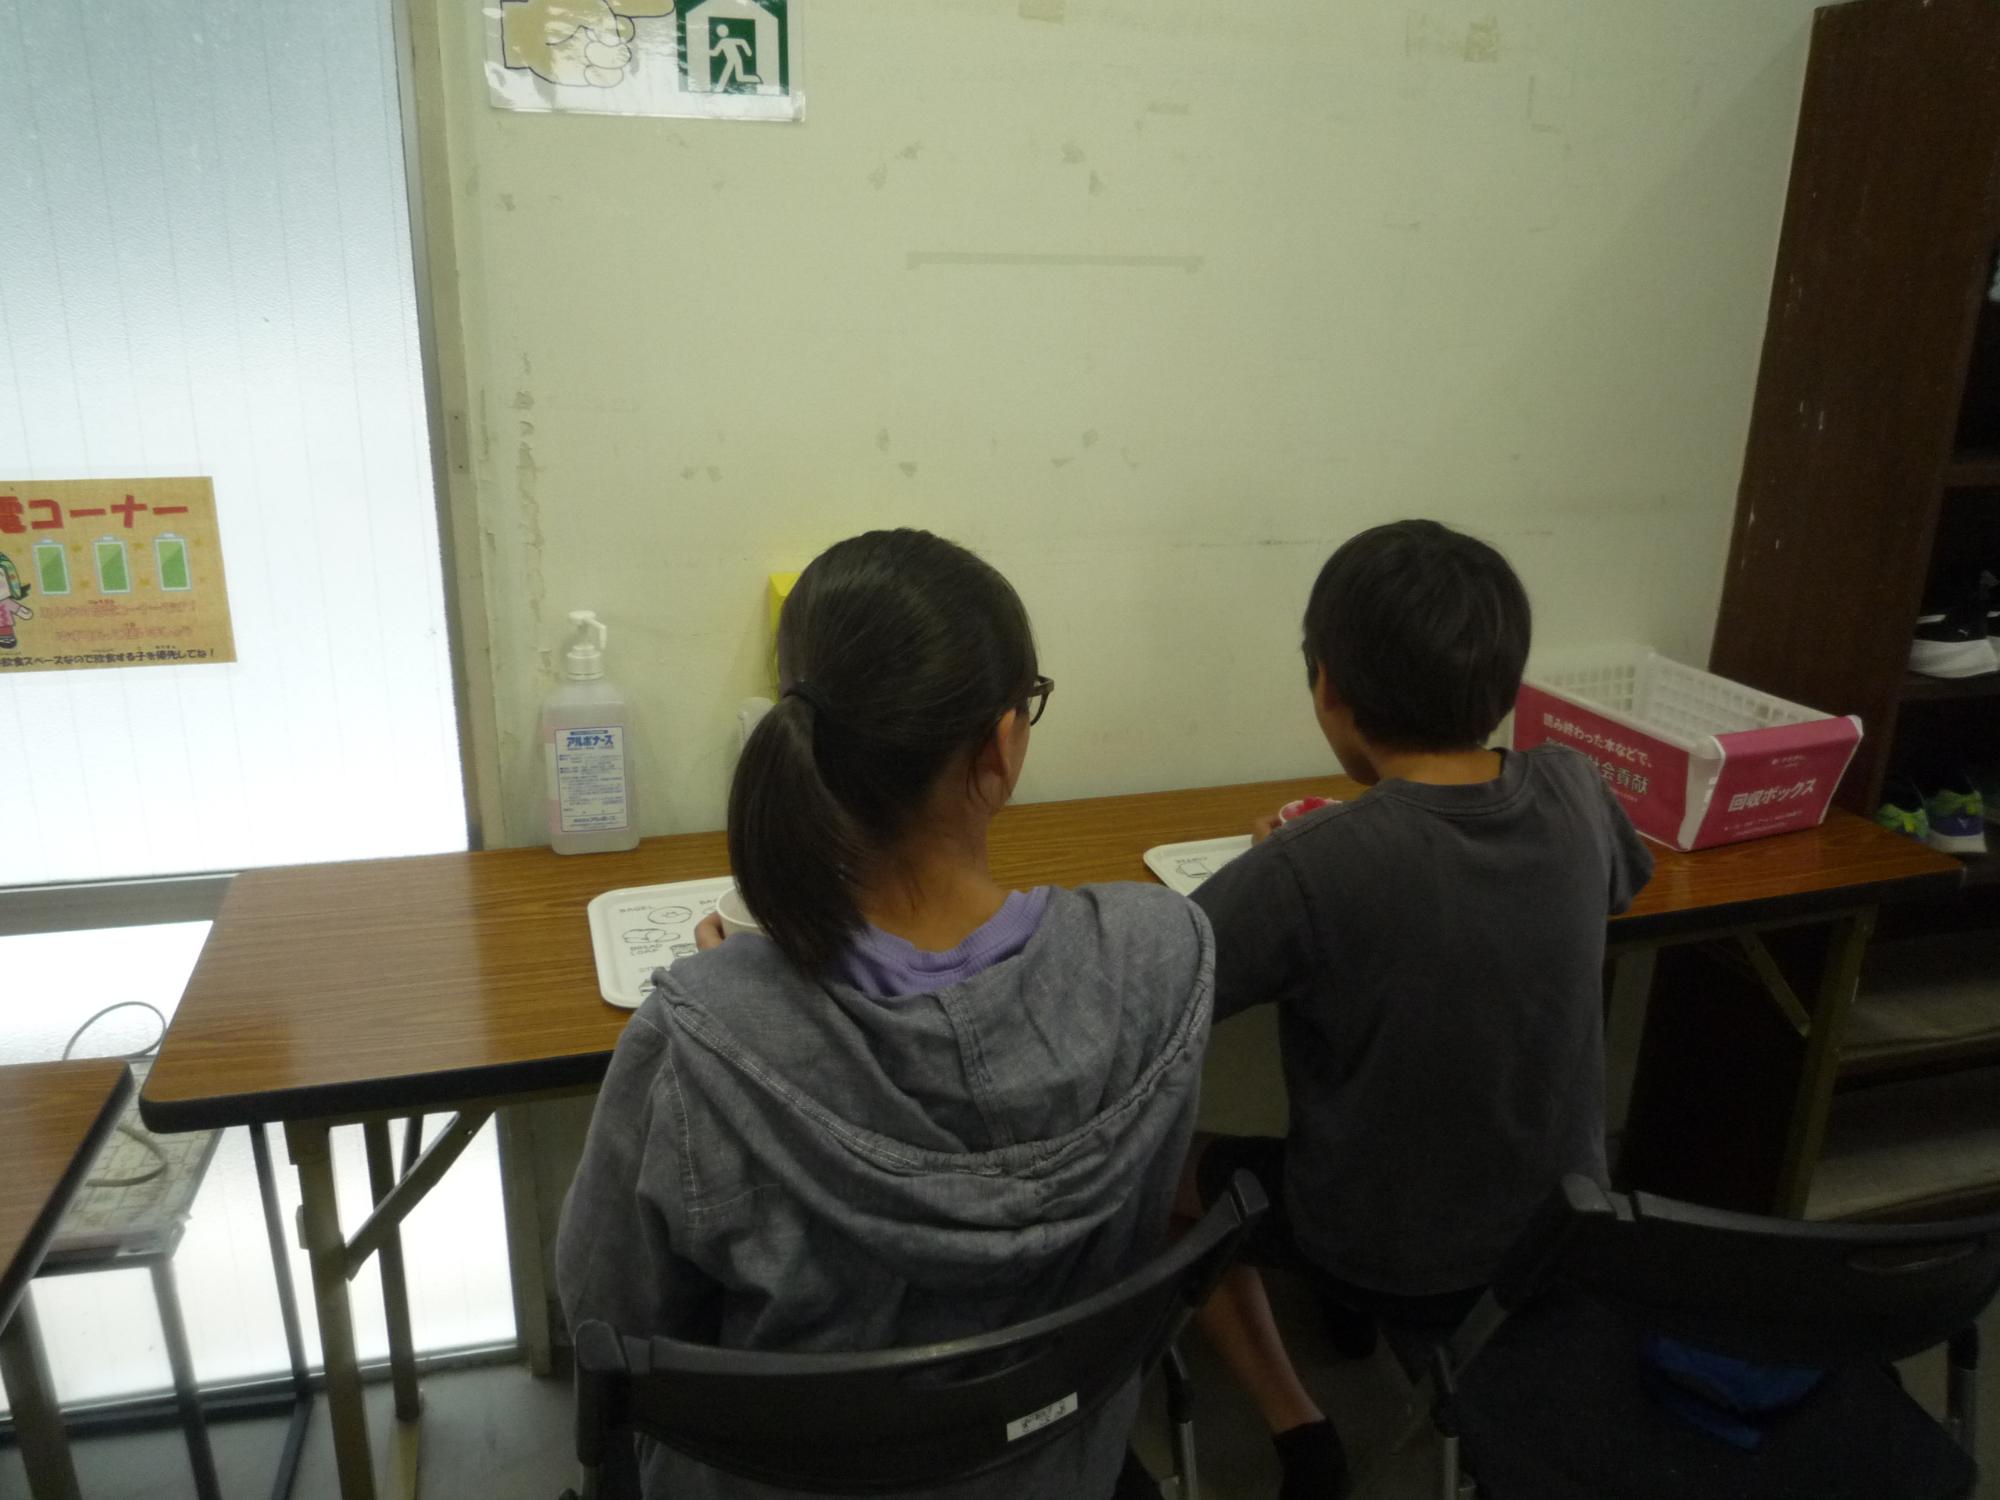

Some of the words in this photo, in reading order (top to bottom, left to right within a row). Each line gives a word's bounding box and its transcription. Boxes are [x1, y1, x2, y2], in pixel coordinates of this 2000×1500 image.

[1727, 778, 1817, 813] 回収ボックス
